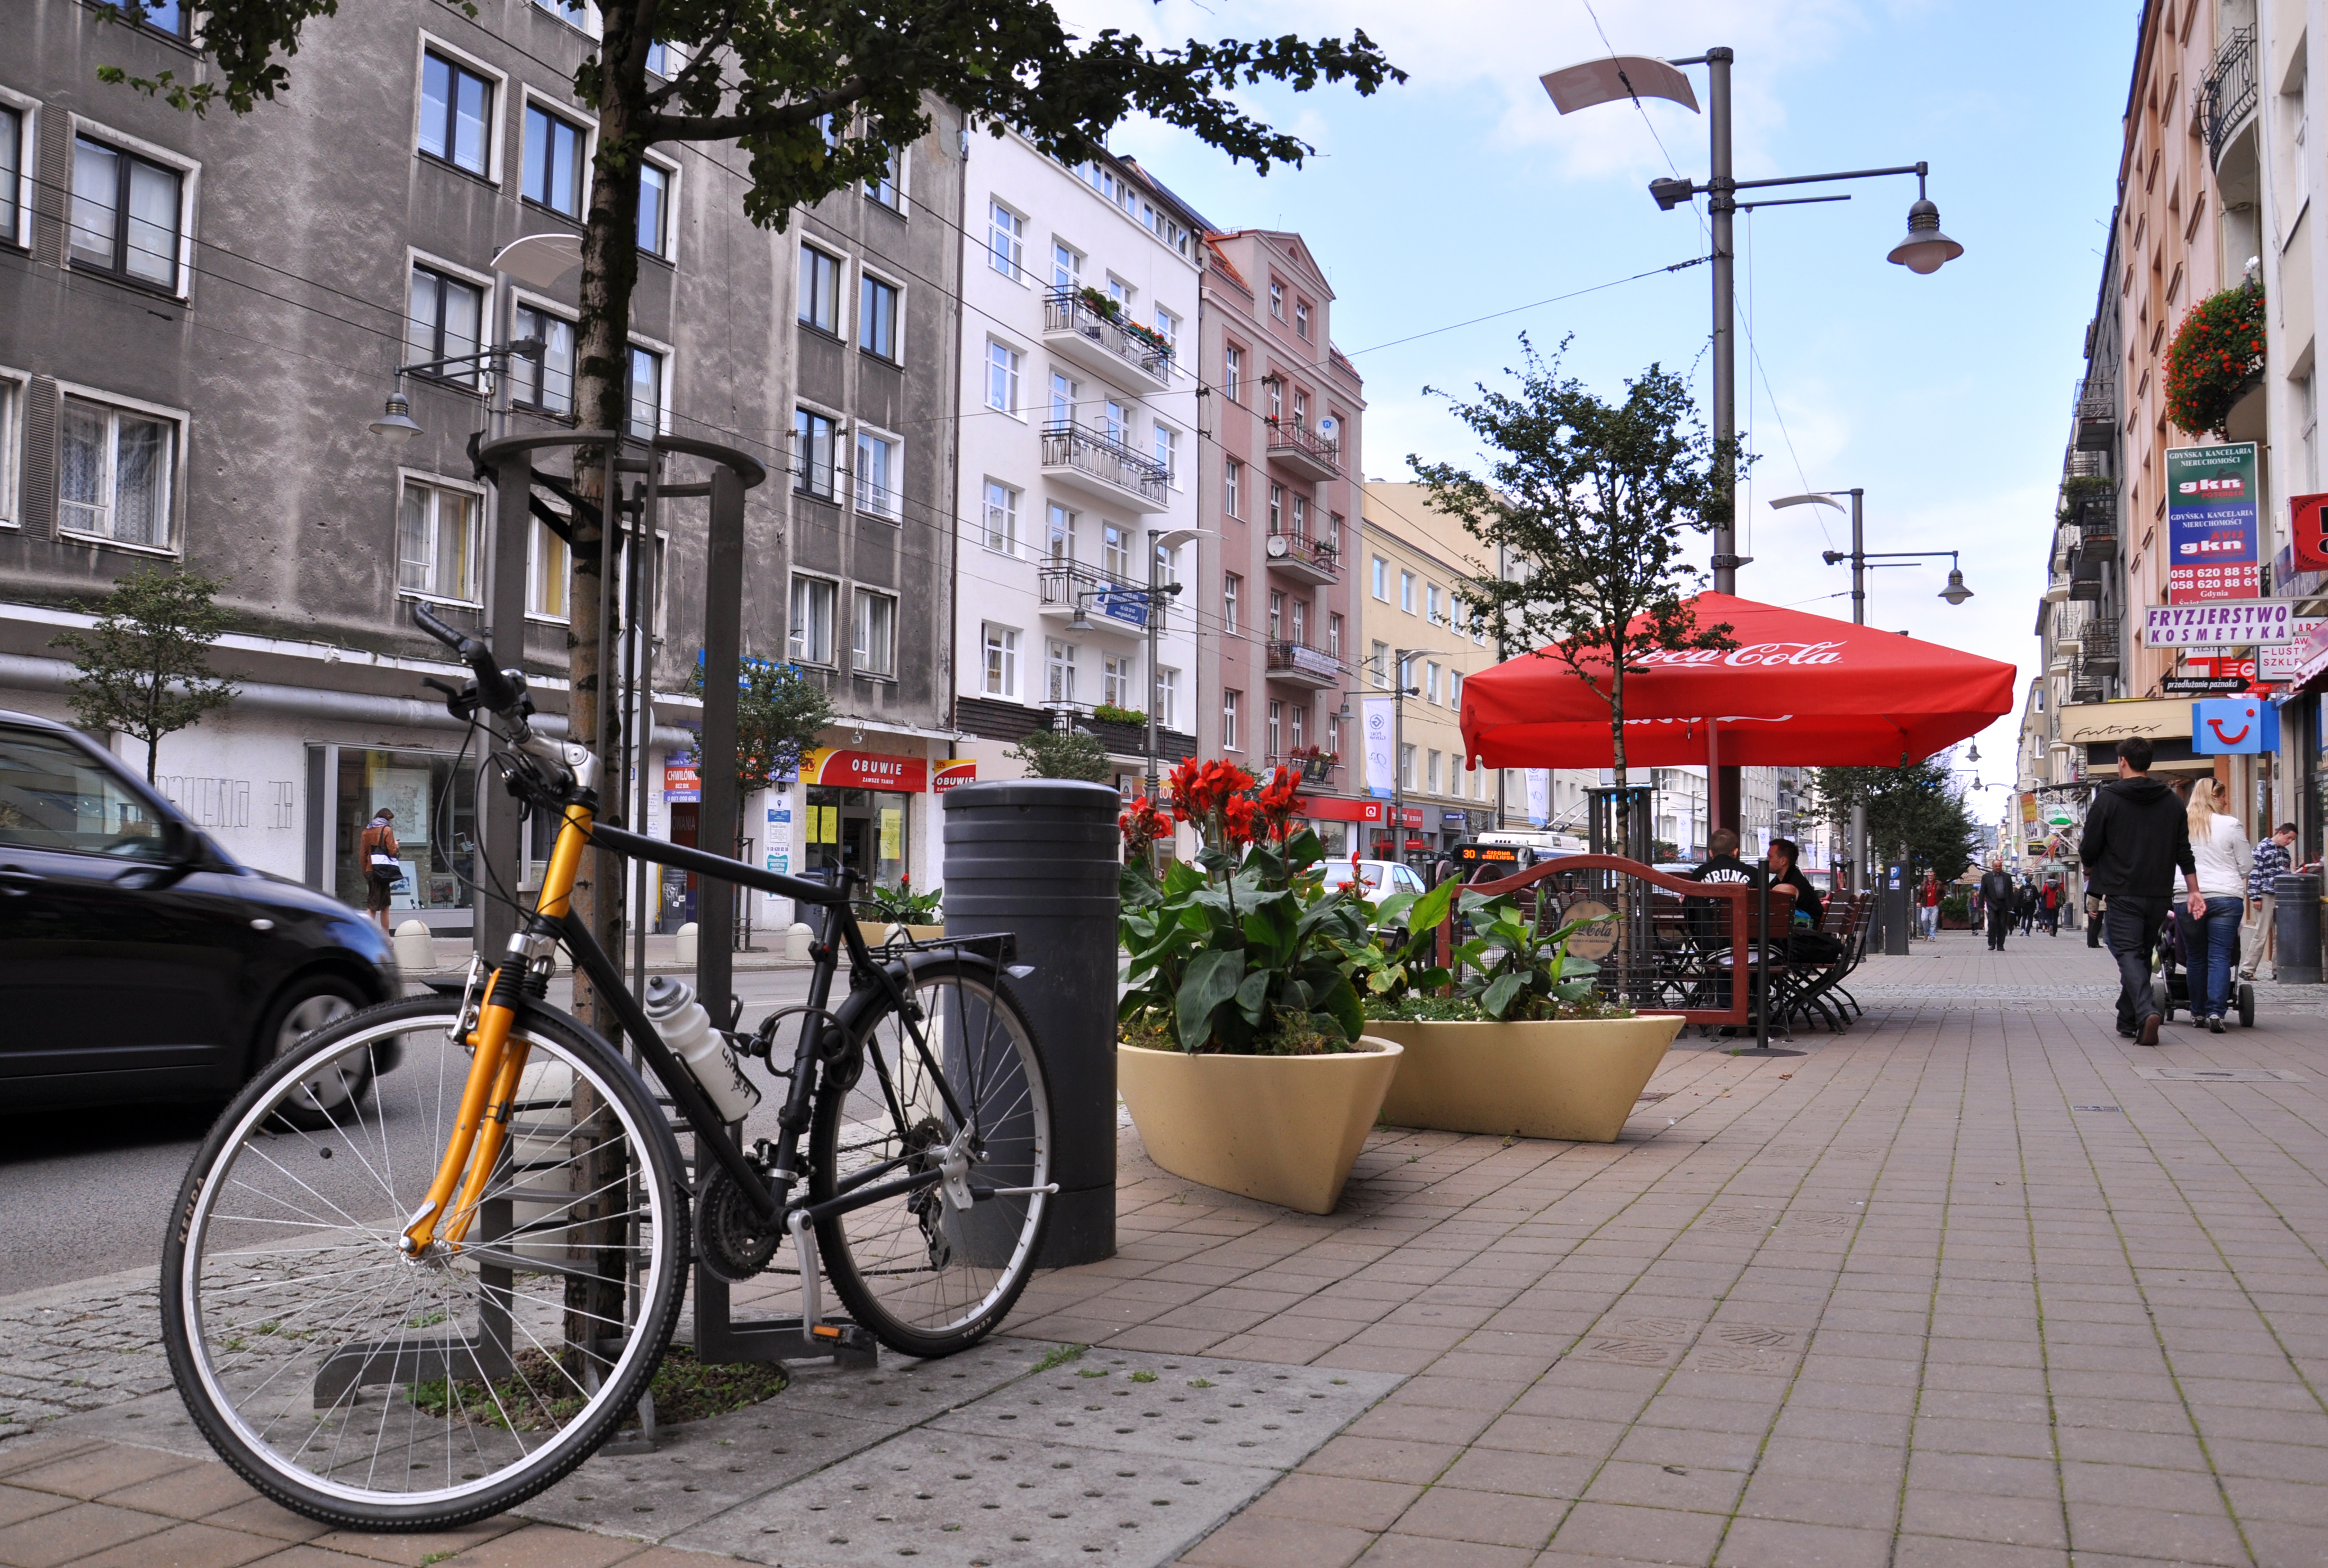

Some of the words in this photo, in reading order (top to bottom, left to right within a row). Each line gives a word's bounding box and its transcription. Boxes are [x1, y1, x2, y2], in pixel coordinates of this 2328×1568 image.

[2169, 450, 2203, 459] GDYŃSKA
[2205, 448, 2252, 457] KANCELARIA
[2181, 456, 2241, 467] NIERUCHOMOŚCI
[2179, 479, 2243, 494] gkn
[2171, 512, 2204, 521] GDYŃSKA
[2207, 510, 2254, 519] KANCELARIA
[2182, 518, 2242, 528] NIERUCHOMOŚCI
[2210, 530, 2245, 540] AVIS
[2180, 540, 2244, 555] gkn
[2171, 569, 2194, 579] 058
[2197, 568, 2221, 578] 620
[2224, 567, 2240, 576] 88
[2243, 566, 2258, 575] 51
[2171, 580, 2194, 590] 058
[2197, 579, 2221, 589] 620
[2224, 578, 2240, 587] 88
[2243, 577, 2258, 586] 61
[2149, 606, 2287, 627] FRYZJERSTWO
[2151, 626, 2285, 642] KOSMETYKA
[1724, 640, 1848, 666] Cola
[2167, 679, 2208, 690] przedłużanie
[2209, 680, 2238, 690] paznokci
[852, 758, 902, 776] OBUWIE
[1463, 849, 1476, 859] 30
[178, 1177, 205, 1244] KENDA
[962, 1315, 992, 1338] KENDA
